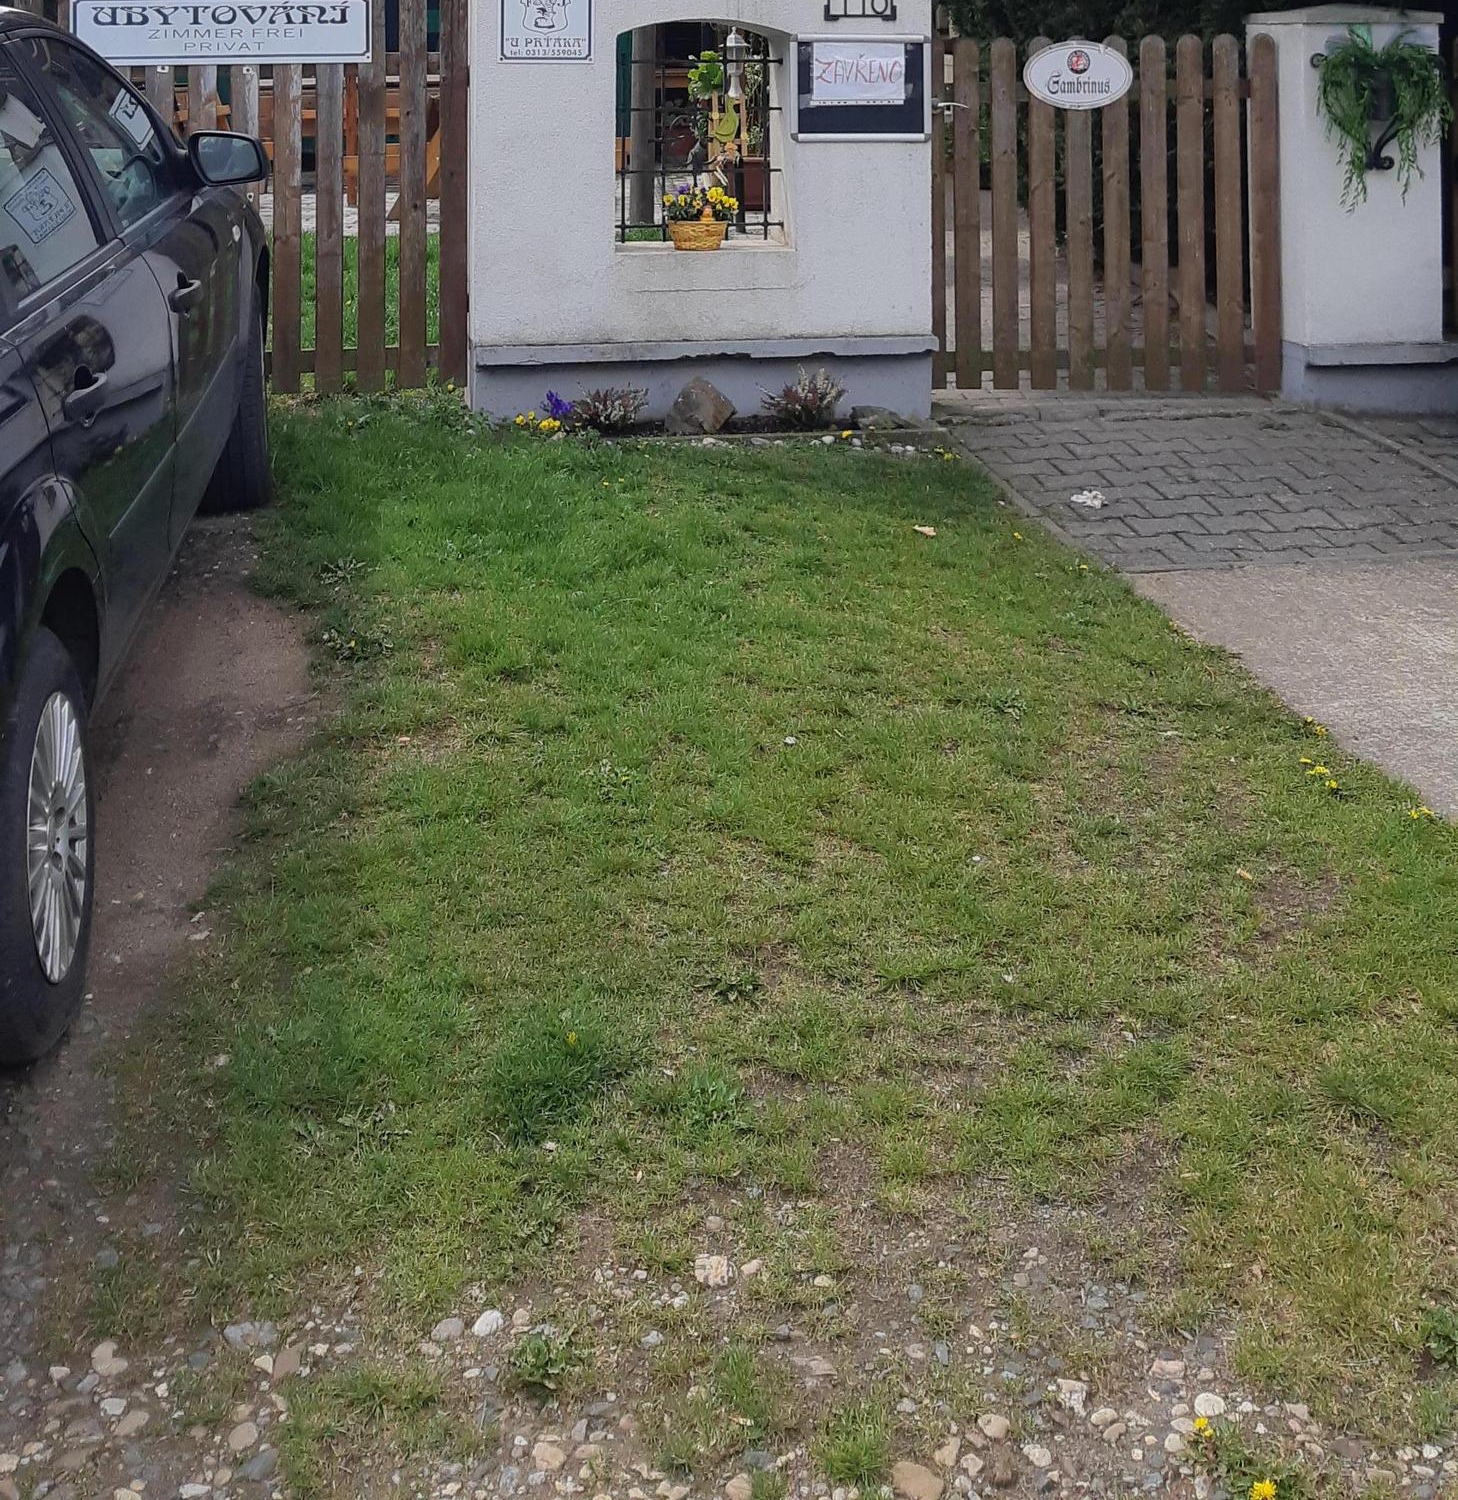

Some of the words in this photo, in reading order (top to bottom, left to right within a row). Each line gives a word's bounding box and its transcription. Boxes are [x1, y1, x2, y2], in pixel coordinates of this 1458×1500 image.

[91, 1, 351, 27] UBYTOVÁNÍ
[148, 28, 248, 40] ZIMMER
[252, 28, 304, 39] FREI
[184, 41, 265, 52] PRIVAT
[815, 52, 903, 84] ZAVŘENO
[1046, 71, 1111, 95] Gambrinus
